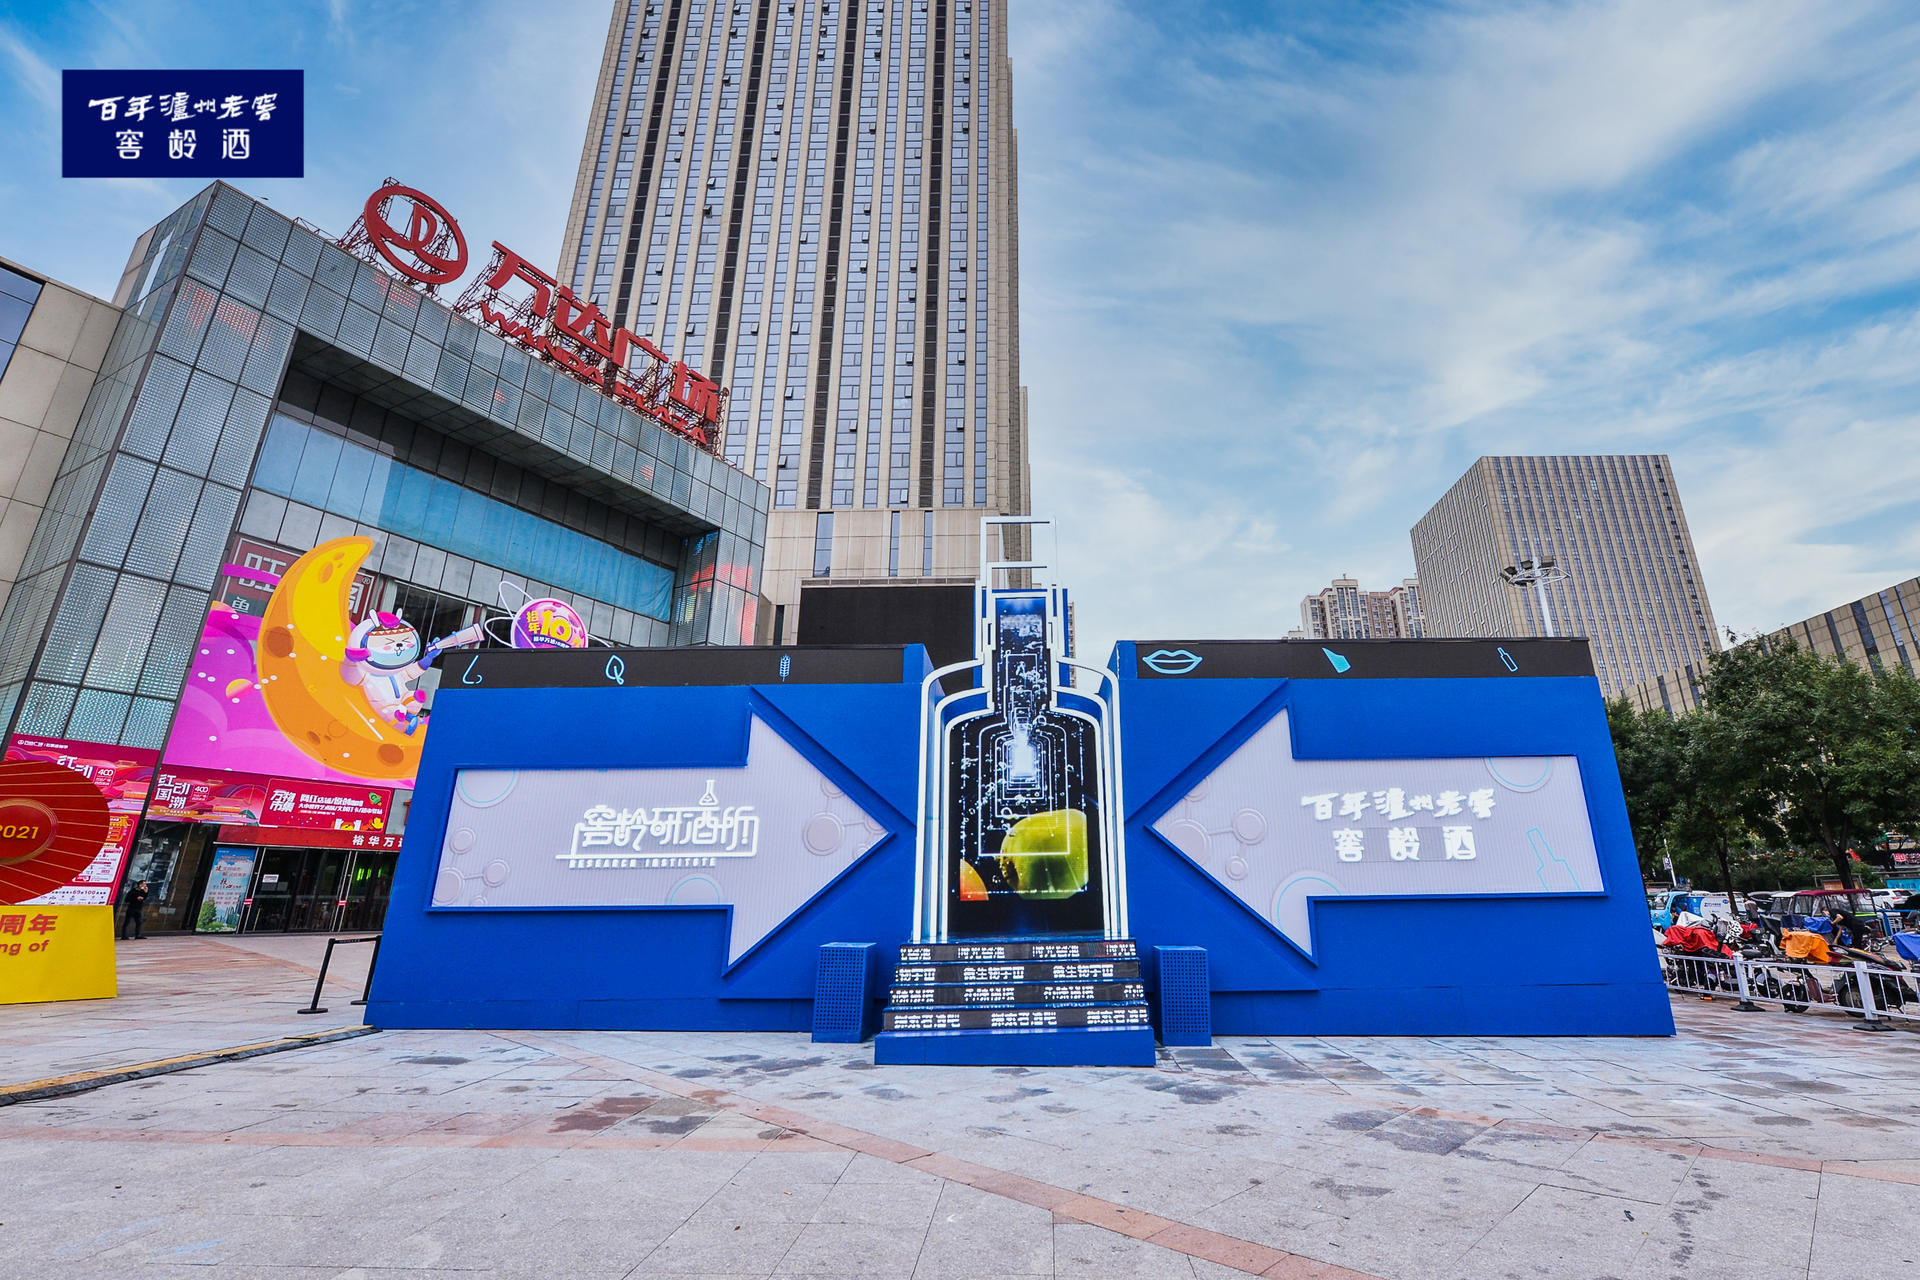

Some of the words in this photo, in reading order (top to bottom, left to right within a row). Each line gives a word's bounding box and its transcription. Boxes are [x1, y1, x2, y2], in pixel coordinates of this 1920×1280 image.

[480, 301, 605, 386] WANDA
[613, 381, 708, 444] PLAZA
[485, 240, 720, 422] 万达广场
[1332, 825, 1477, 863] 窖龄酒
[28, 939, 51, 953] of
